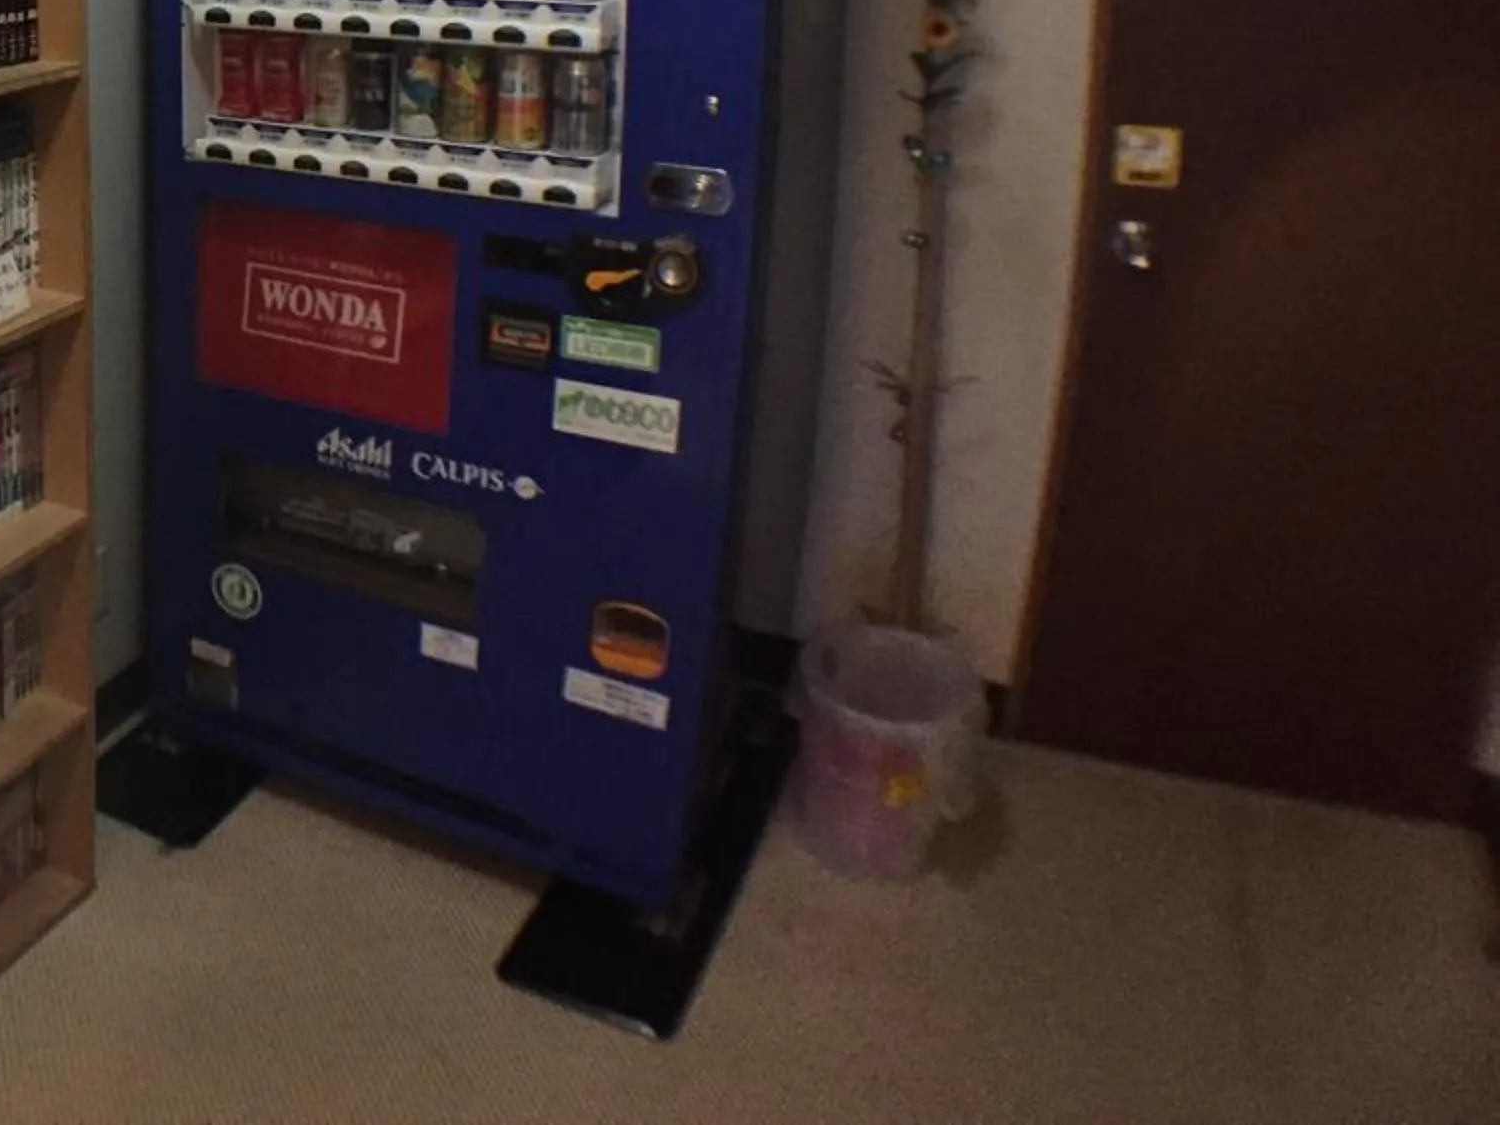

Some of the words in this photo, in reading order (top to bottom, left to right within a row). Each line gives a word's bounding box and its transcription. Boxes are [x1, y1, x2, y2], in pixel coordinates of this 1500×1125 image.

[260, 278, 388, 332] WONDA
[317, 427, 393, 469] Asahi
[411, 450, 505, 493] CALPIS
